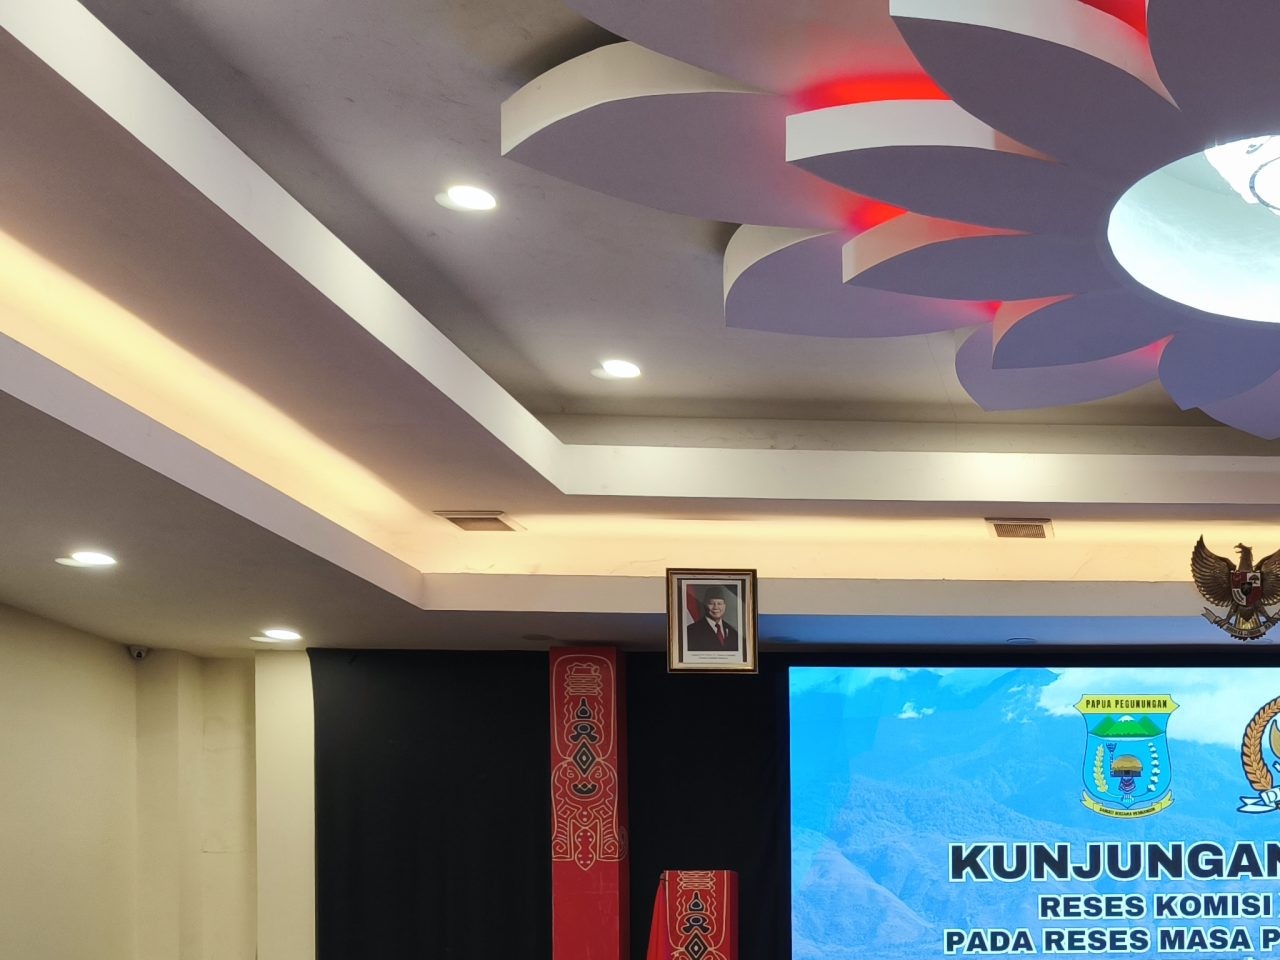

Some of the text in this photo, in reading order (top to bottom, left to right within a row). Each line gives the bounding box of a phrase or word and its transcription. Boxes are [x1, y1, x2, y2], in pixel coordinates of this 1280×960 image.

[1085, 698, 1168, 709] PAPUA PEGUNUNGAN
[1039, 895, 1145, 918] RESES
[1155, 894, 1272, 917] KOMISI
[945, 930, 1034, 952] PADA
[1044, 930, 1149, 951] RESES
[1159, 928, 1252, 950] MASA
